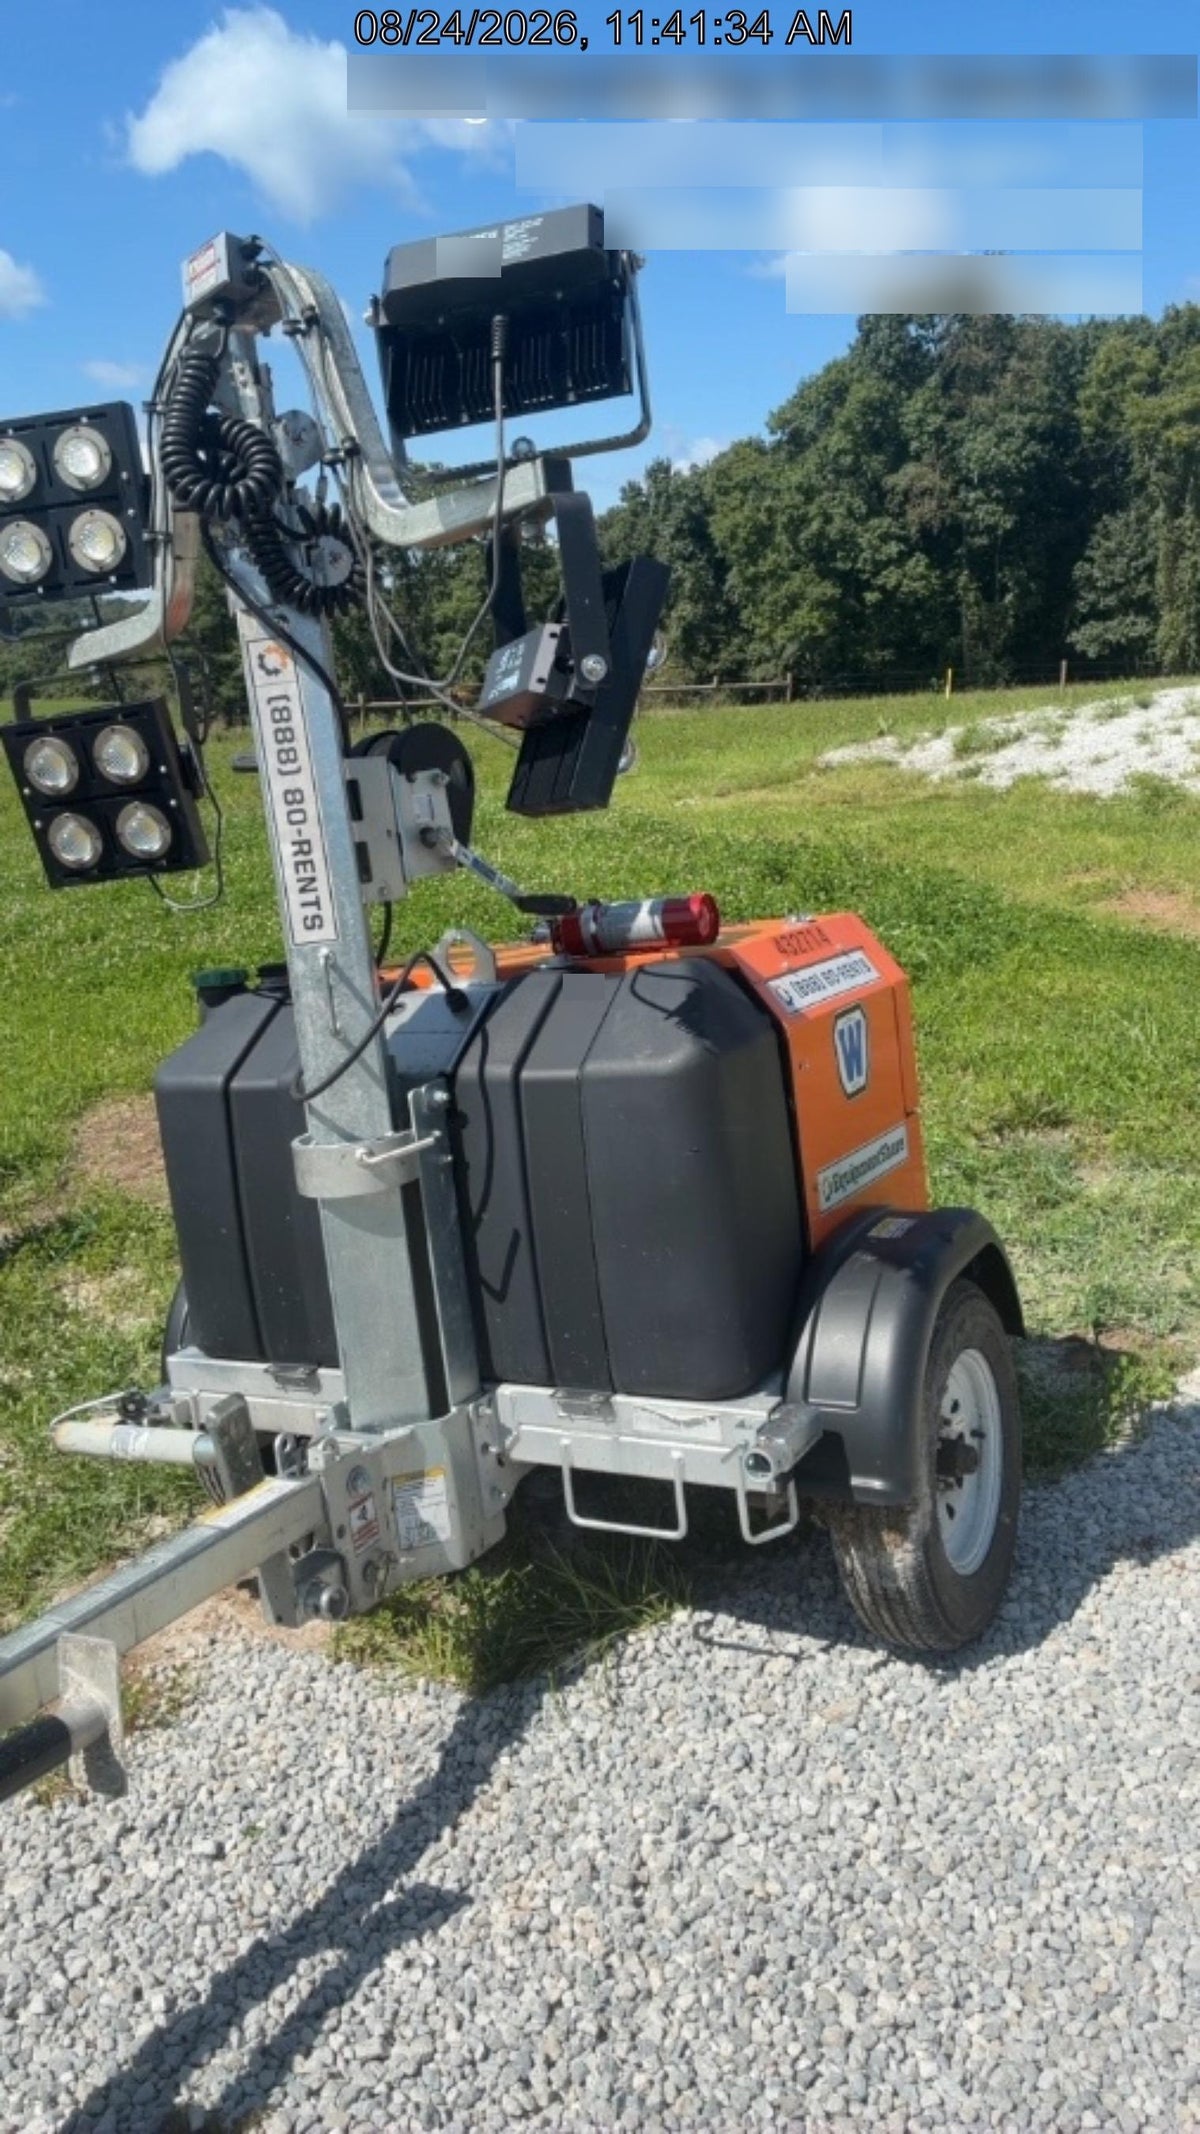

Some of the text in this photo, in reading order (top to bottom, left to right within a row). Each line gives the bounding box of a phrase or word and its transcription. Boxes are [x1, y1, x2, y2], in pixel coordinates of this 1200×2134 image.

[267, 694, 324, 932] (888) 80-RENTS
[838, 1018, 864, 1083] W
